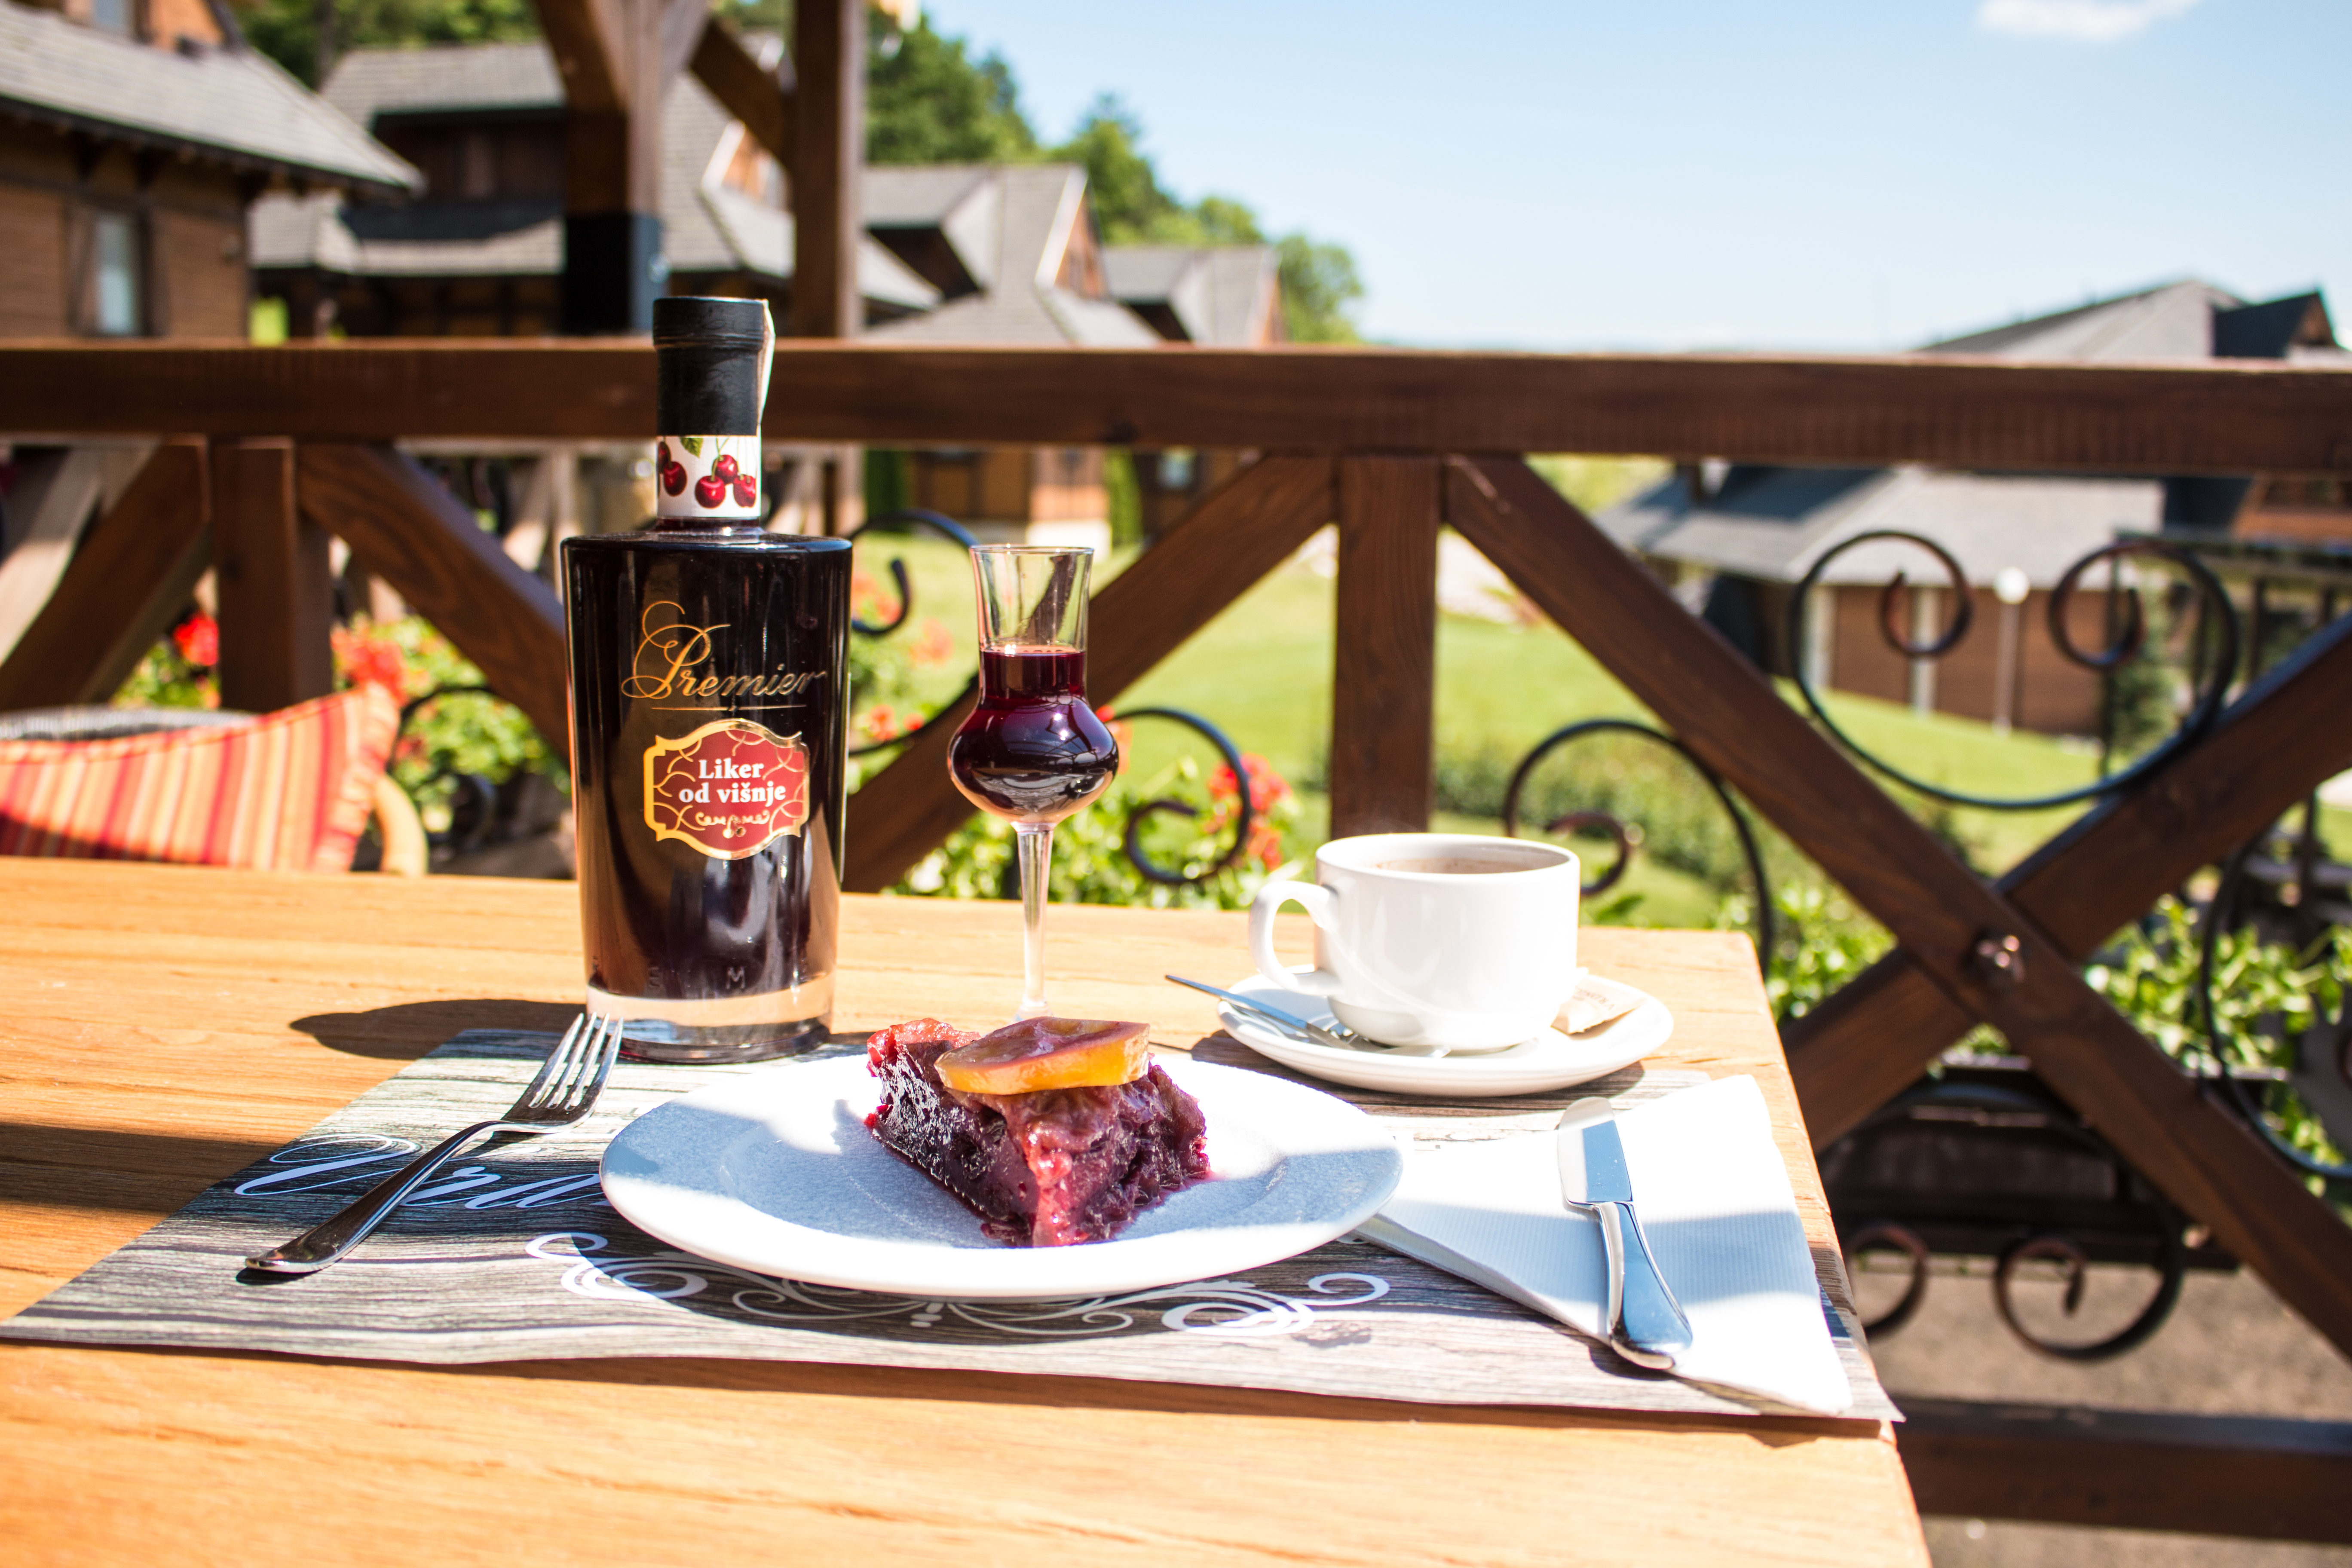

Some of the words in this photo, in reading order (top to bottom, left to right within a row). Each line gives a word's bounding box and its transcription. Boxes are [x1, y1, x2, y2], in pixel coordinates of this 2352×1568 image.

[621, 601, 827, 699] Premier
[698, 758, 764, 779] Liker
[679, 782, 710, 803] od
[716, 781, 786, 807] višnje
